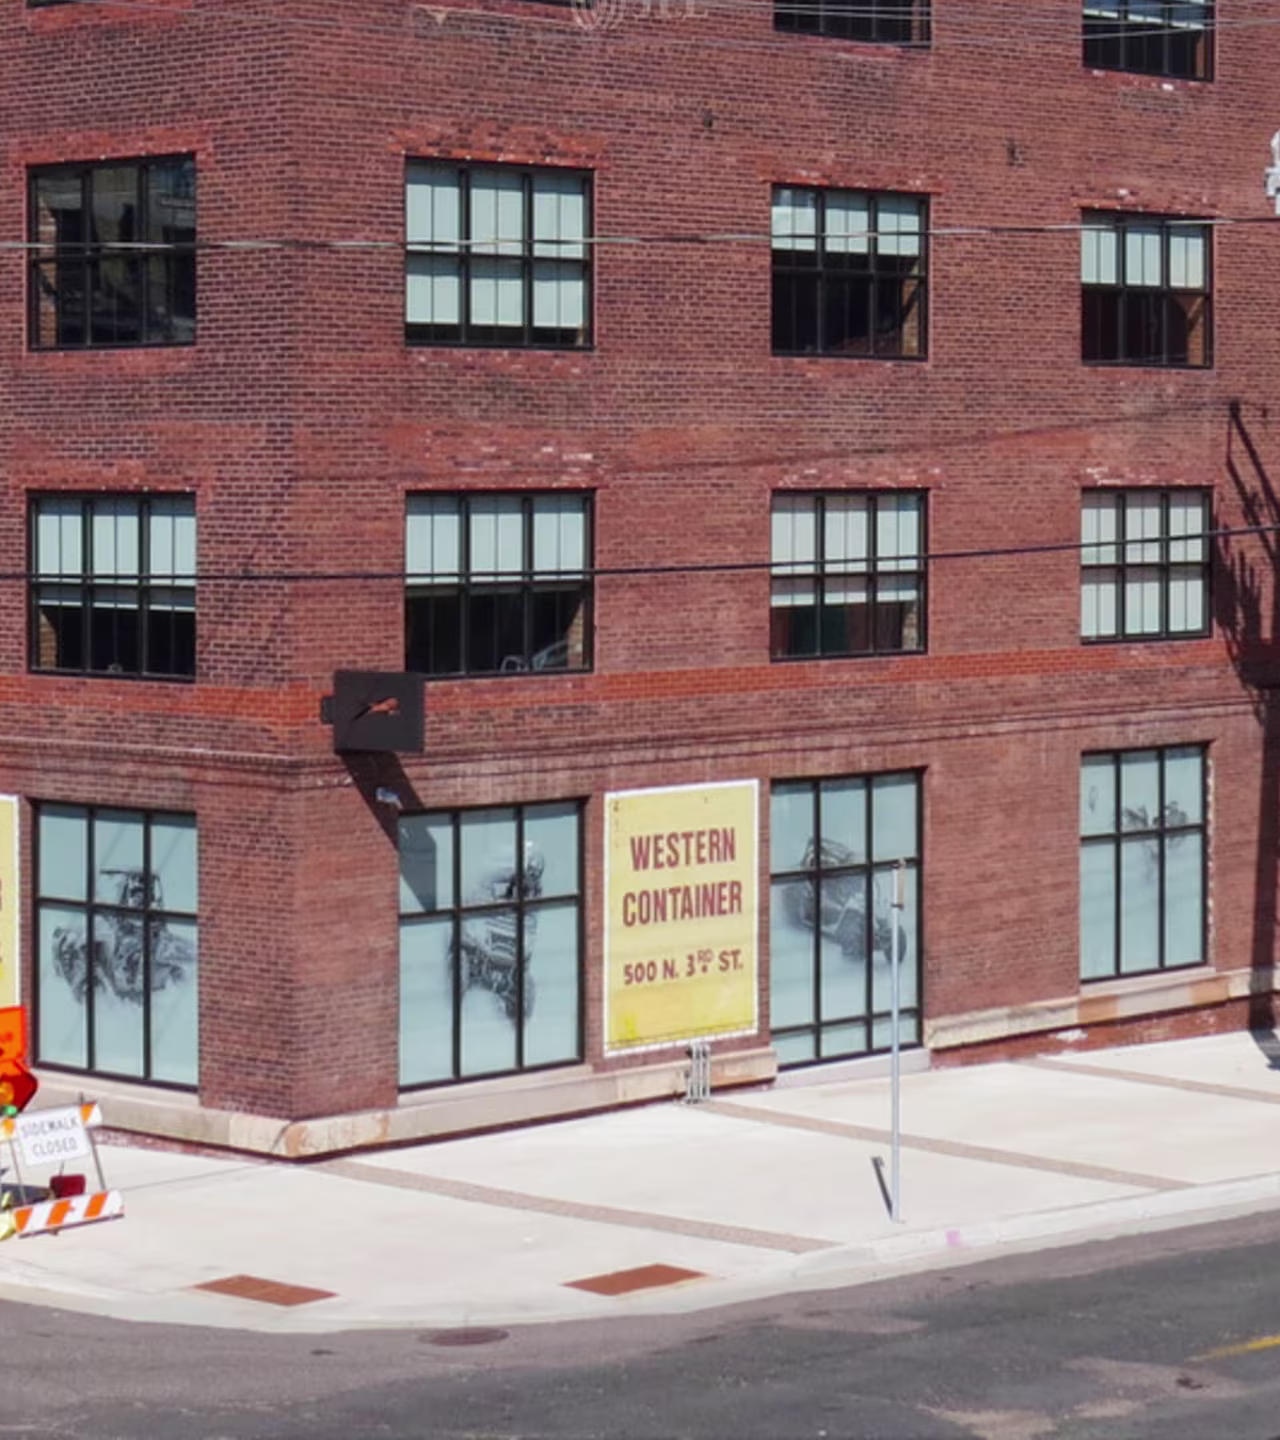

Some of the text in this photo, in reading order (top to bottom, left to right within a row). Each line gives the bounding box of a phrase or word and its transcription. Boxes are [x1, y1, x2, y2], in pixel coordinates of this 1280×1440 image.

[630, 827, 736, 872] WESTERN
[622, 880, 743, 928] CONTAINER
[624, 960, 657, 985] 500
[662, 958, 679, 980] N.
[718, 949, 743, 972] ST.
[19, 1116, 79, 1138] SIDEWALK
[32, 1137, 78, 1157] CLOSED
